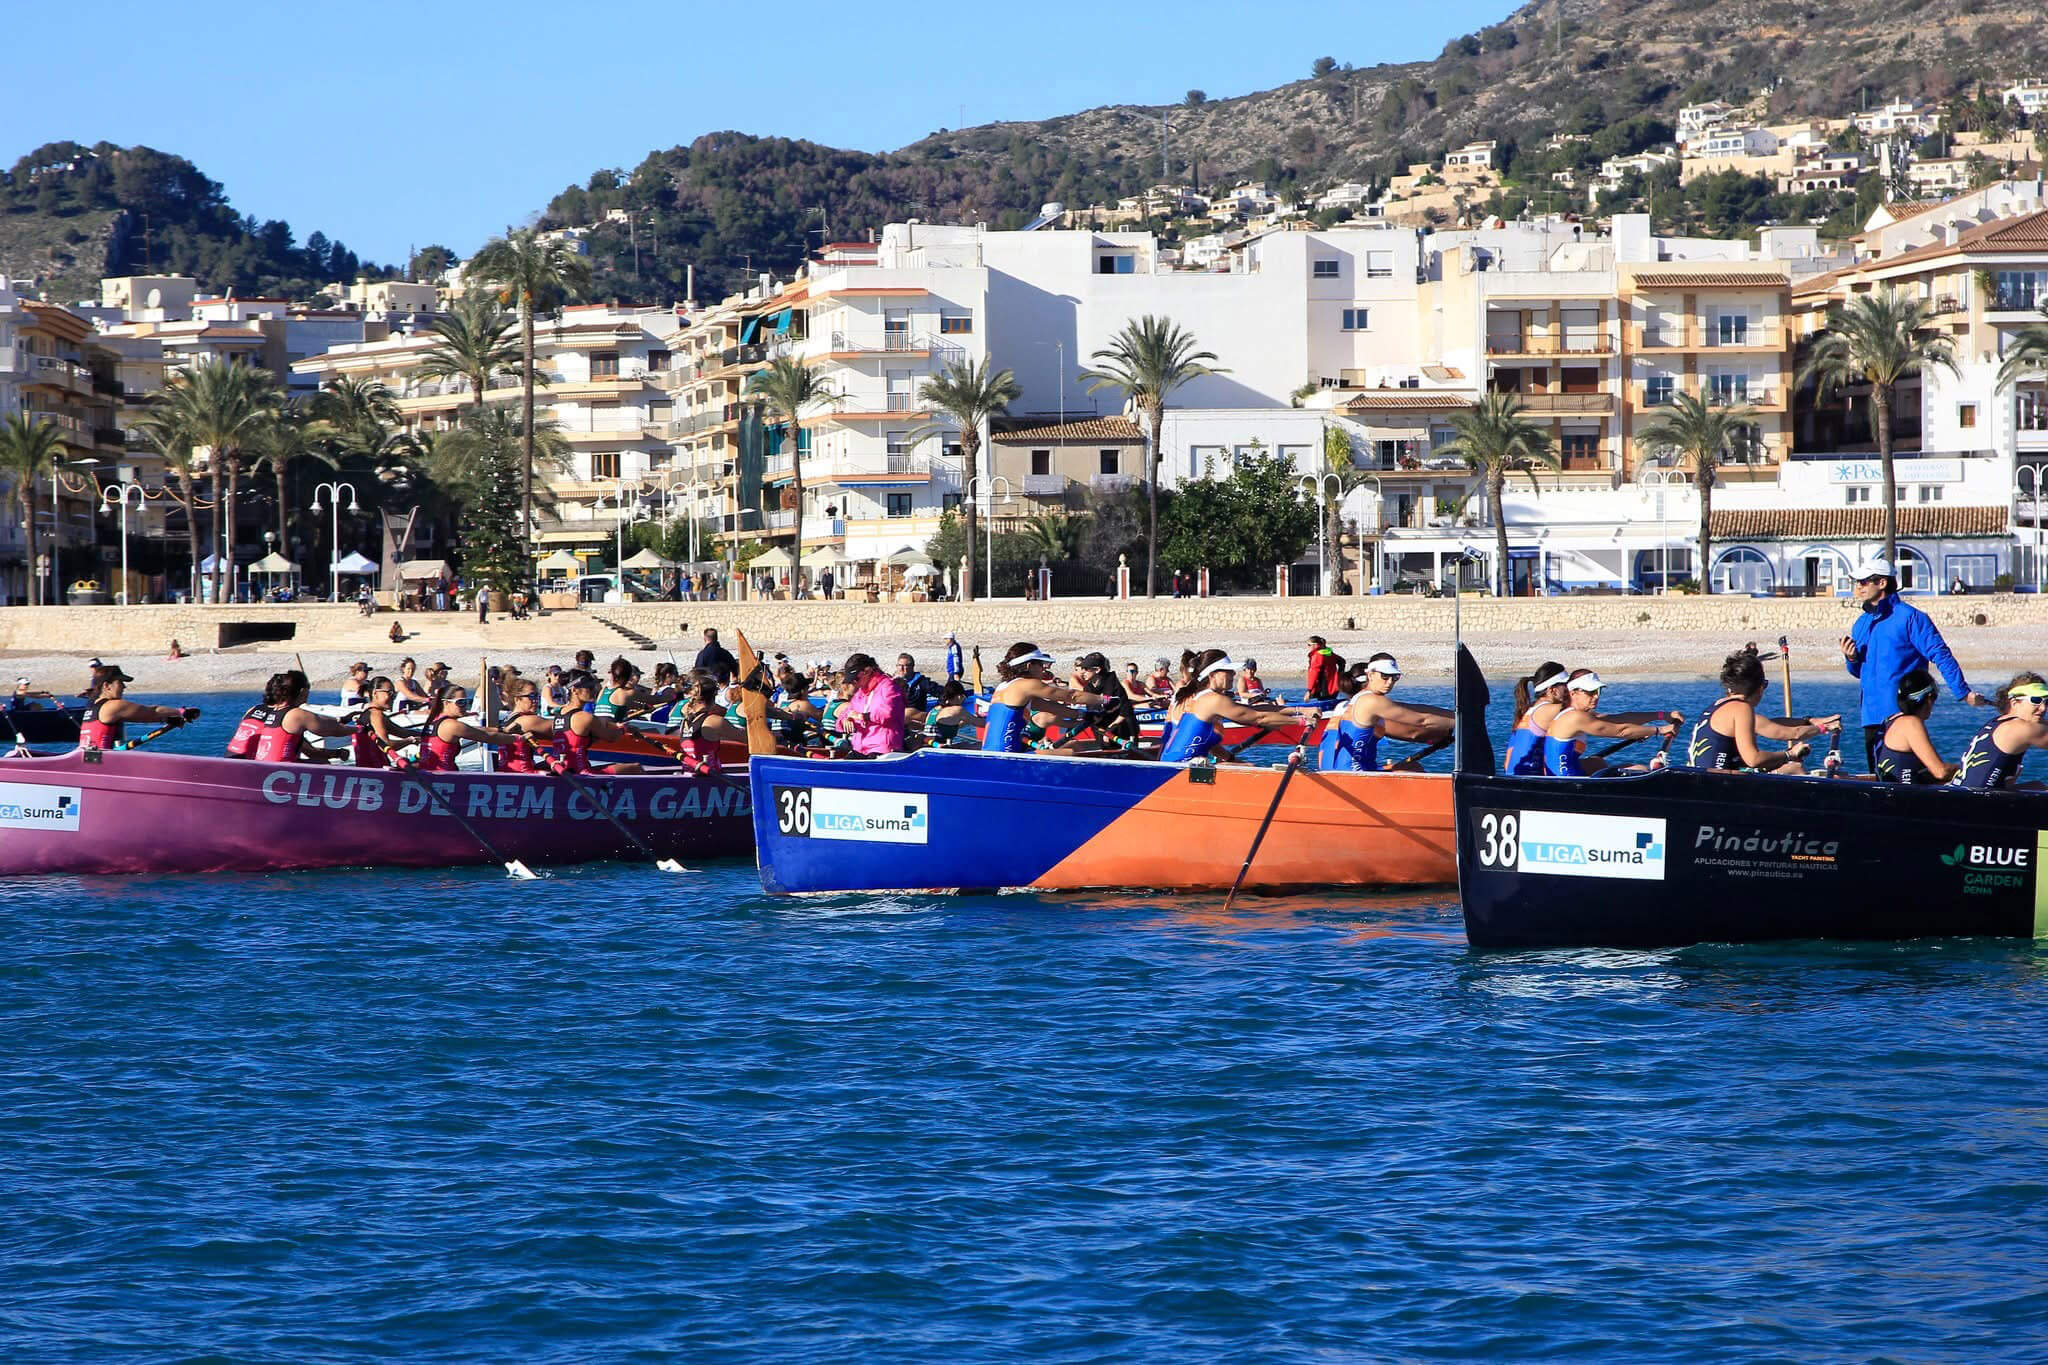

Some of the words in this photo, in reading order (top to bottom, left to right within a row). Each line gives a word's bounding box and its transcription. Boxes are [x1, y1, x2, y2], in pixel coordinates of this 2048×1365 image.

[262, 770, 385, 812] CLUB
[398, 781, 456, 817] DE
[467, 784, 555, 820] REM
[24, 808, 64, 819] suma
[779, 790, 810, 834] 36
[824, 815, 864, 830] LIGA
[866, 818, 910, 831] suma
[1479, 813, 1518, 868] 38
[1695, 825, 1840, 856] Pináutica
[1535, 844, 1585, 863] LIGA
[1587, 849, 1644, 864] suma
[1694, 857, 1752, 868] APLICACIONES
[1969, 845, 2030, 867] BLUE
[1963, 873, 2024, 888] GARDEN
